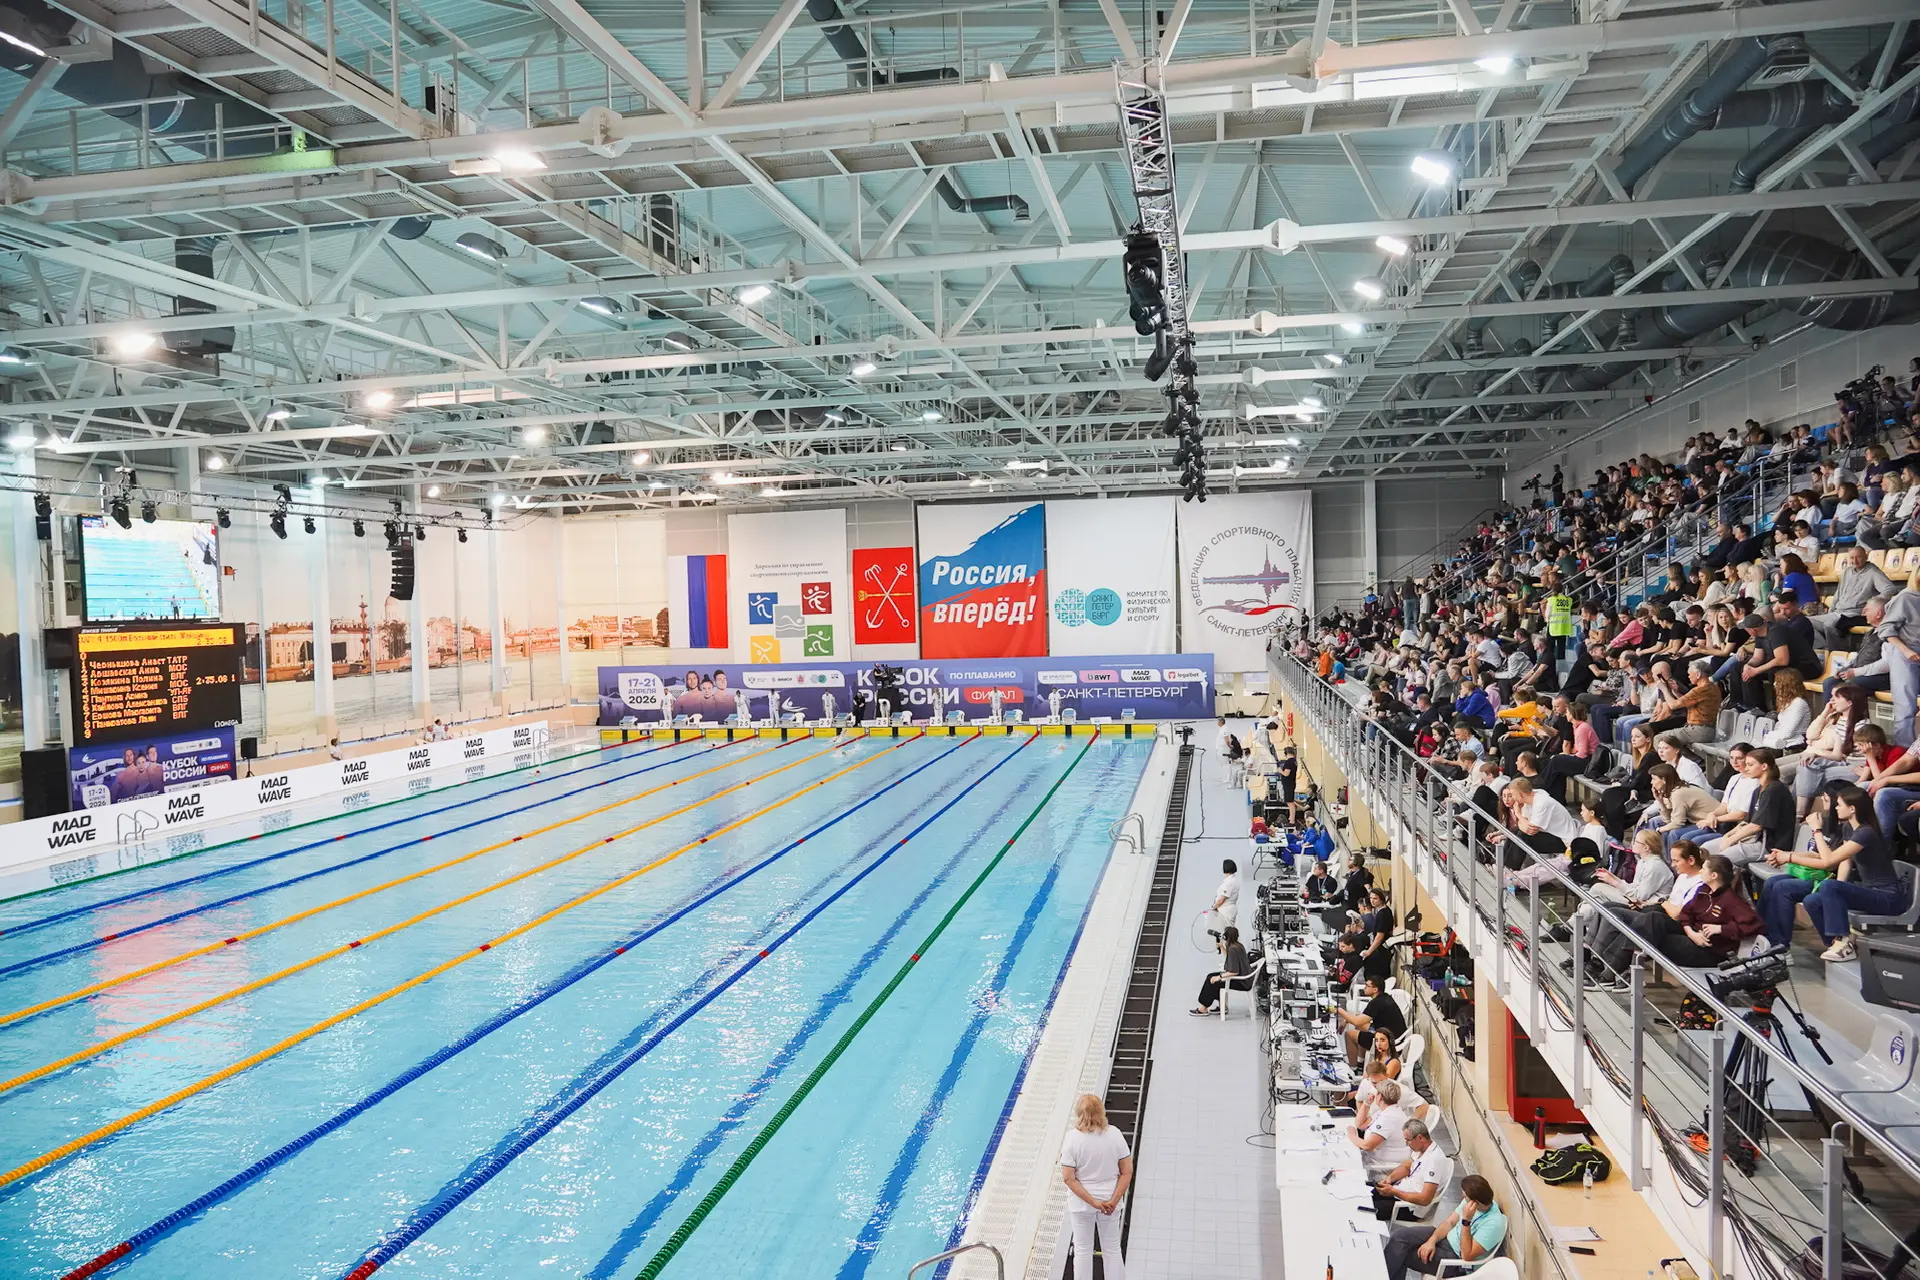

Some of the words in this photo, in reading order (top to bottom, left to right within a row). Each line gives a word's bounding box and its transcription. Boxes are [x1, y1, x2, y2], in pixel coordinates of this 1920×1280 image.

[1211, 526, 1286, 547] СПОРТИВНОГО
[932, 561, 1036, 587] Россия,
[1190, 546, 1211, 607] ФЕДЕРАЦИЯ
[1285, 548, 1302, 604] ПЛАВАНИЯ
[933, 595, 1037, 628] вперёд!
[1092, 603, 1114, 611] ПЕТЕР
[1092, 612, 1110, 620] БУРГ
[167, 656, 188, 664] ТАТР
[81, 669, 88, 678] 2
[169, 664, 188, 672] МОС
[857, 667, 940, 687] КБОК
[965, 671, 1016, 679] ПЛАВАНИЮ
[169, 680, 189, 688] МОС
[628, 678, 656, 687] 17-21
[628, 695, 657, 704] 2026
[1057, 686, 1188, 699] САНКТ-ПЕТЕРБУРГ
[513, 728, 530, 738] MAD
[465, 738, 483, 748] MAD
[512, 737, 532, 748] WAVE
[409, 748, 429, 760] MAD
[464, 747, 485, 758] WAVE
[162, 756, 198, 771] КУБОК
[344, 761, 366, 773] MAD
[407, 758, 431, 771] WAVE
[163, 765, 206, 782] РОССИИ
[341, 771, 369, 785] WAVE
[261, 776, 288, 790] MAD
[88, 788, 106, 796] 17-21
[258, 787, 291, 804] WAVE
[168, 793, 200, 810] MAD
[165, 806, 204, 824] WAVE
[52, 815, 91, 833] MAD
[48, 830, 97, 849] WAVE
